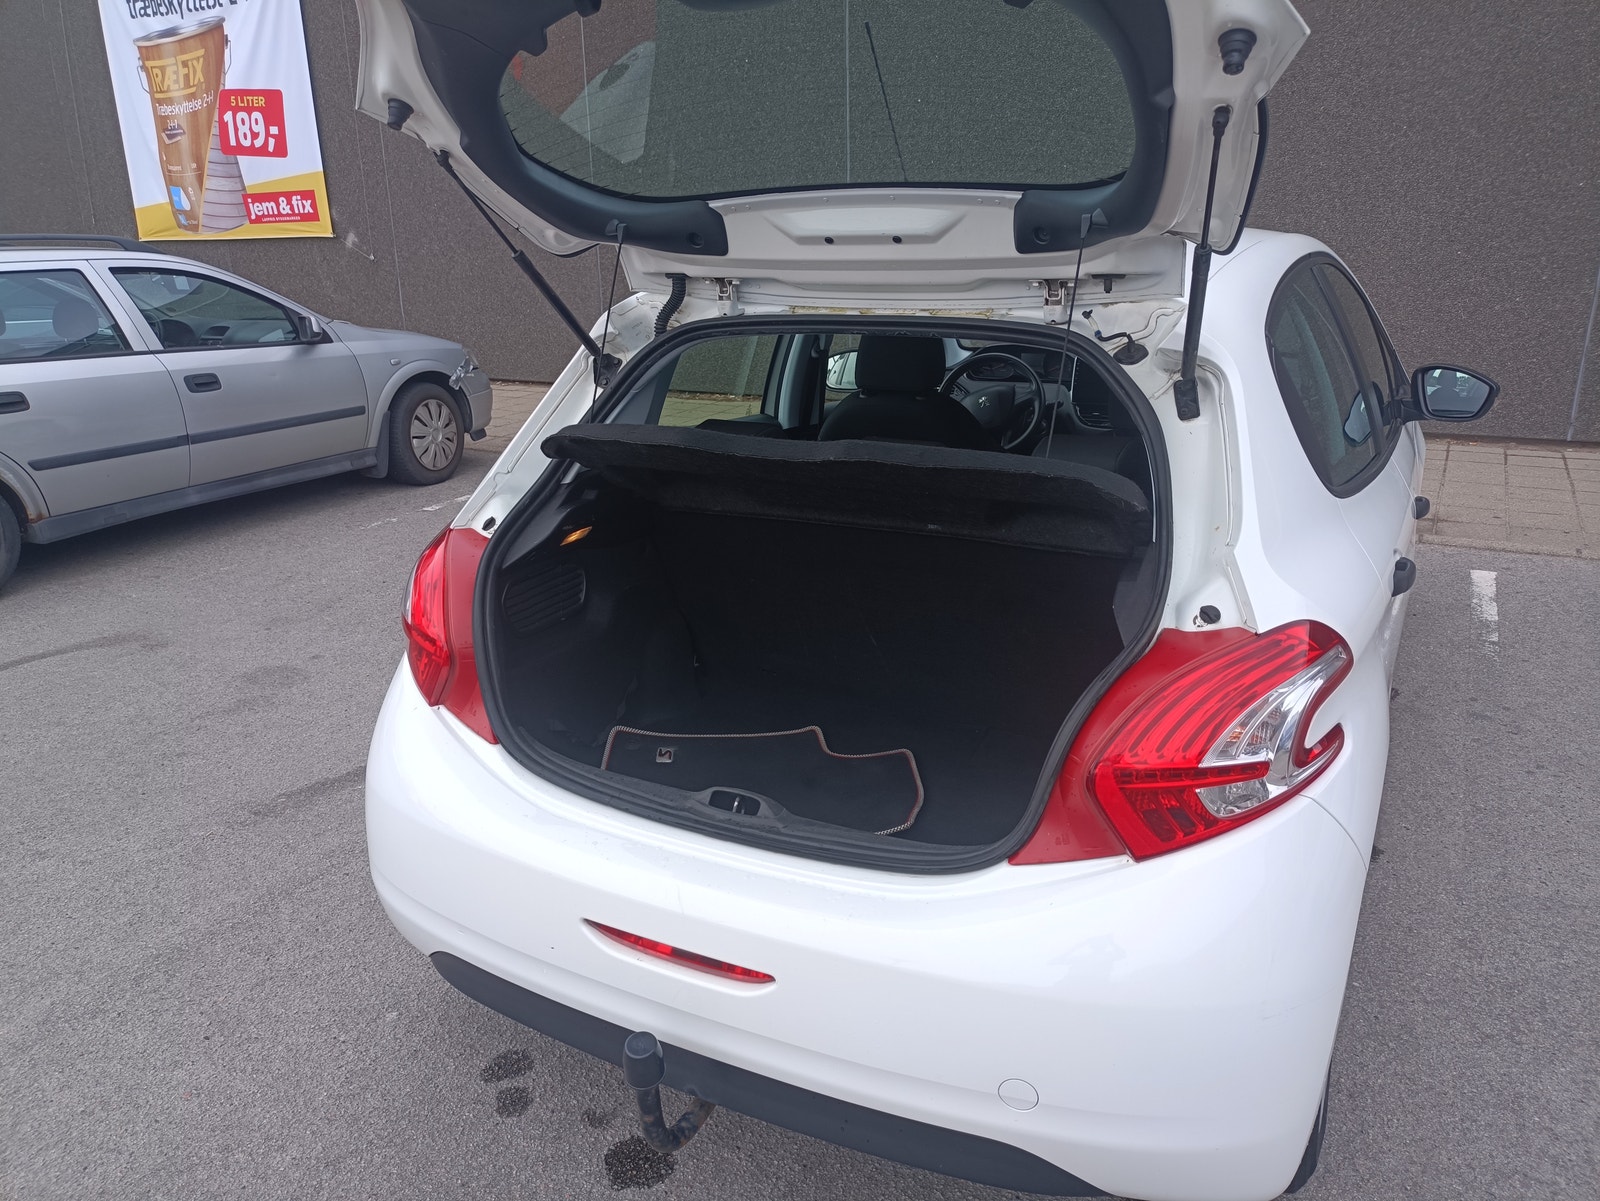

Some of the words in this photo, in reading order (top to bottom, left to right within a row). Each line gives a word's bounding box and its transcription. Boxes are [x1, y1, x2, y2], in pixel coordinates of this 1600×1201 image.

[156, 98, 202, 116] Træbeskyttelse
[230, 95, 236, 107] 5
[238, 95, 266, 107] LITER
[223, 110, 279, 153] 189,-
[247, 198, 278, 220] jem
[278, 196, 292, 214] &
[292, 195, 314, 214] fix
